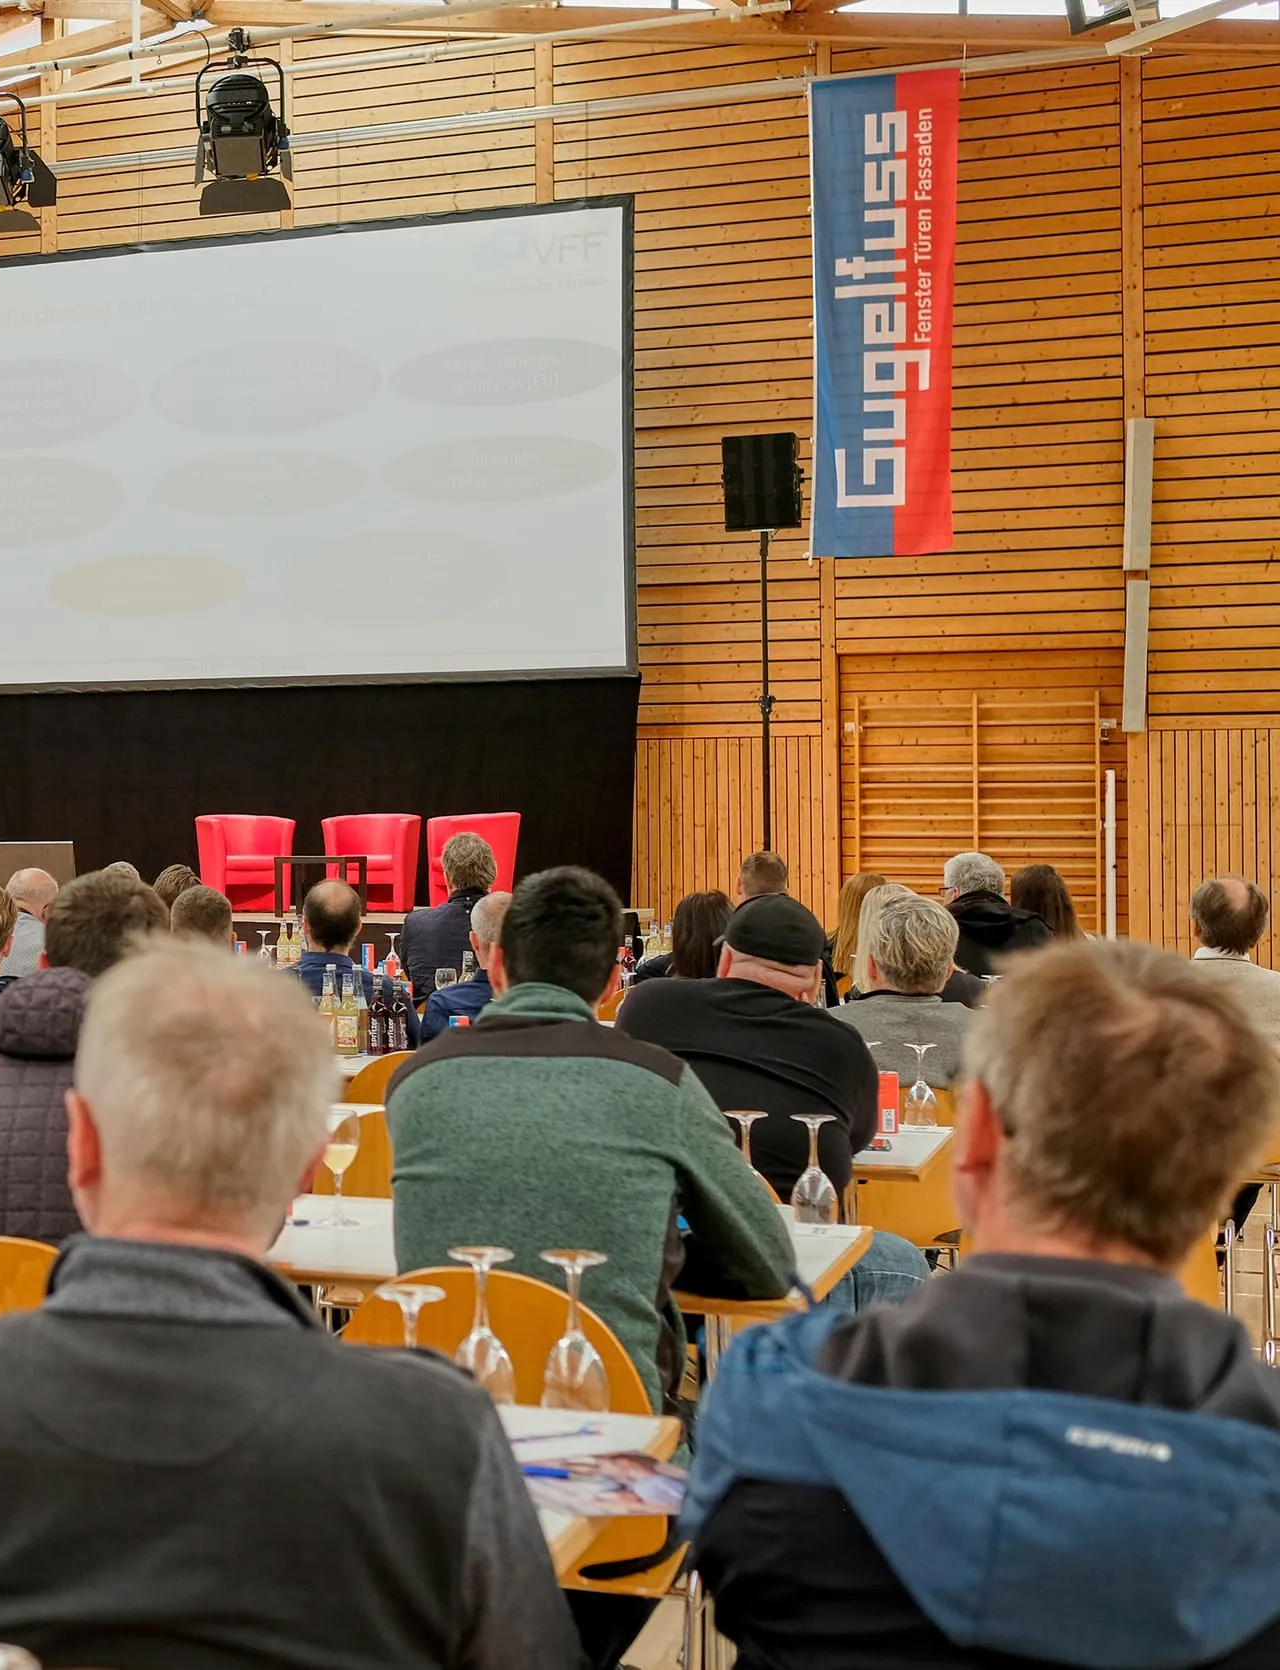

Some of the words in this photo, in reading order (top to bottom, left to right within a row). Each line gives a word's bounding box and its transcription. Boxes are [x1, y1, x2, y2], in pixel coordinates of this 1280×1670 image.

[915, 107, 933, 202] Fassaden
[914, 208, 933, 264] Türen
[833, 110, 931, 508] Gugelfuss
[913, 268, 932, 343] Fenster
